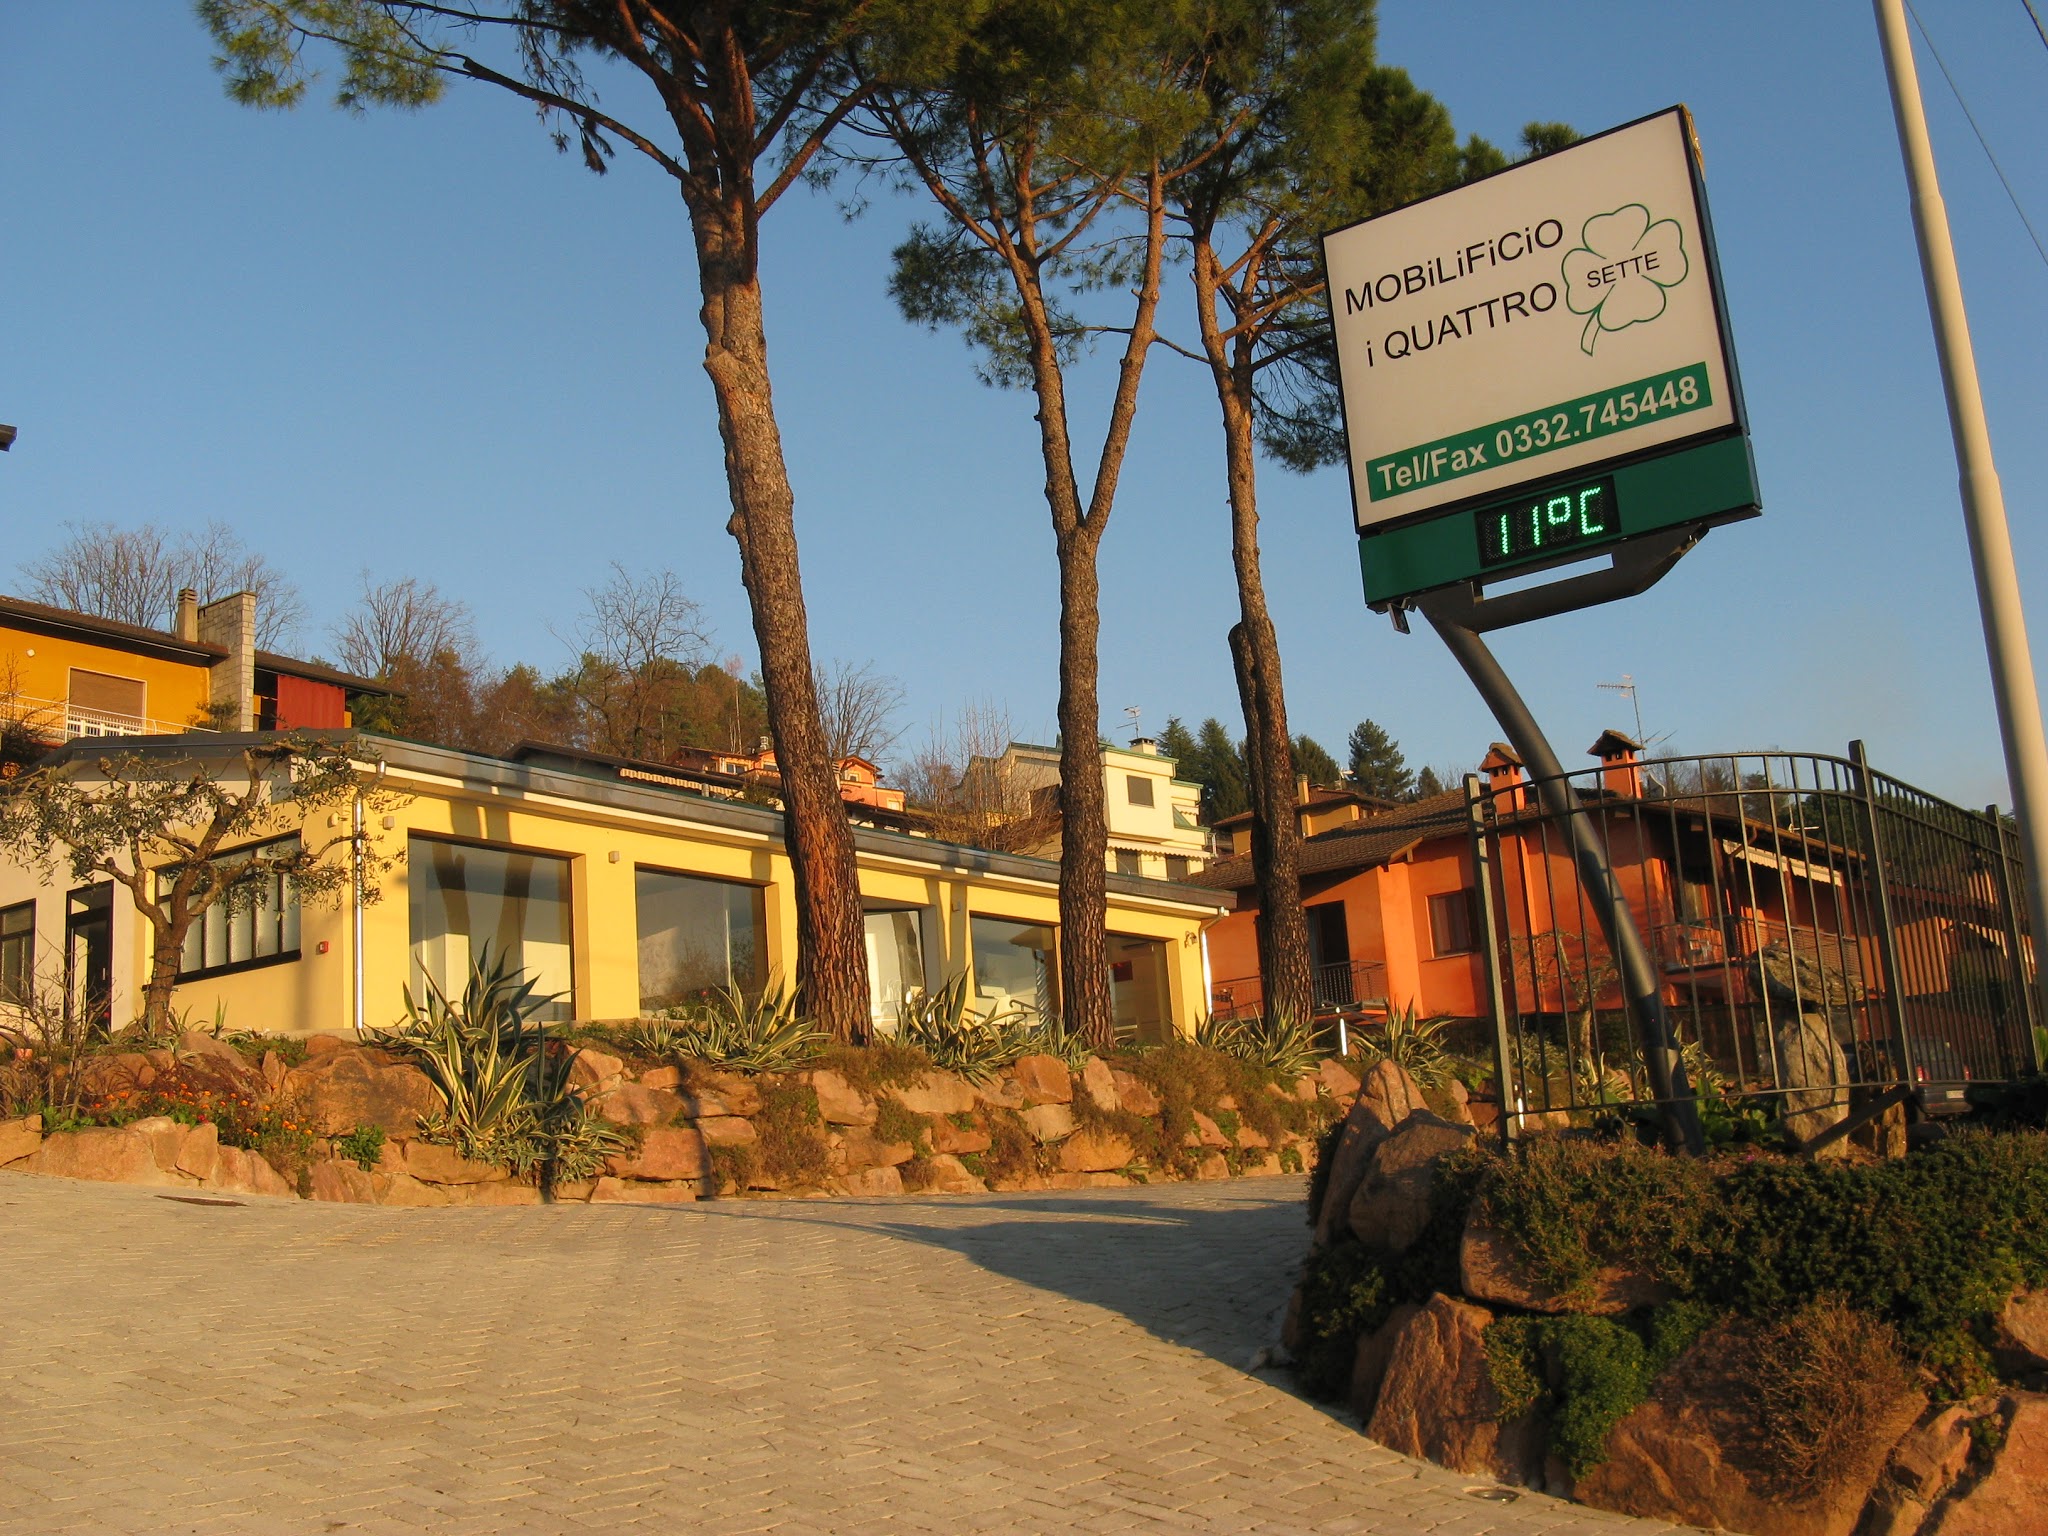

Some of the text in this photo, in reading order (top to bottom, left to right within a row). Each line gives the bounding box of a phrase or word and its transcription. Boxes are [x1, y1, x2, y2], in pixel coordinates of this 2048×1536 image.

[1586, 251, 1660, 289] SETTE
[1366, 282, 1557, 367] i QUATTRO
[1377, 375, 1699, 492] Tel/Fax 0332.745448
